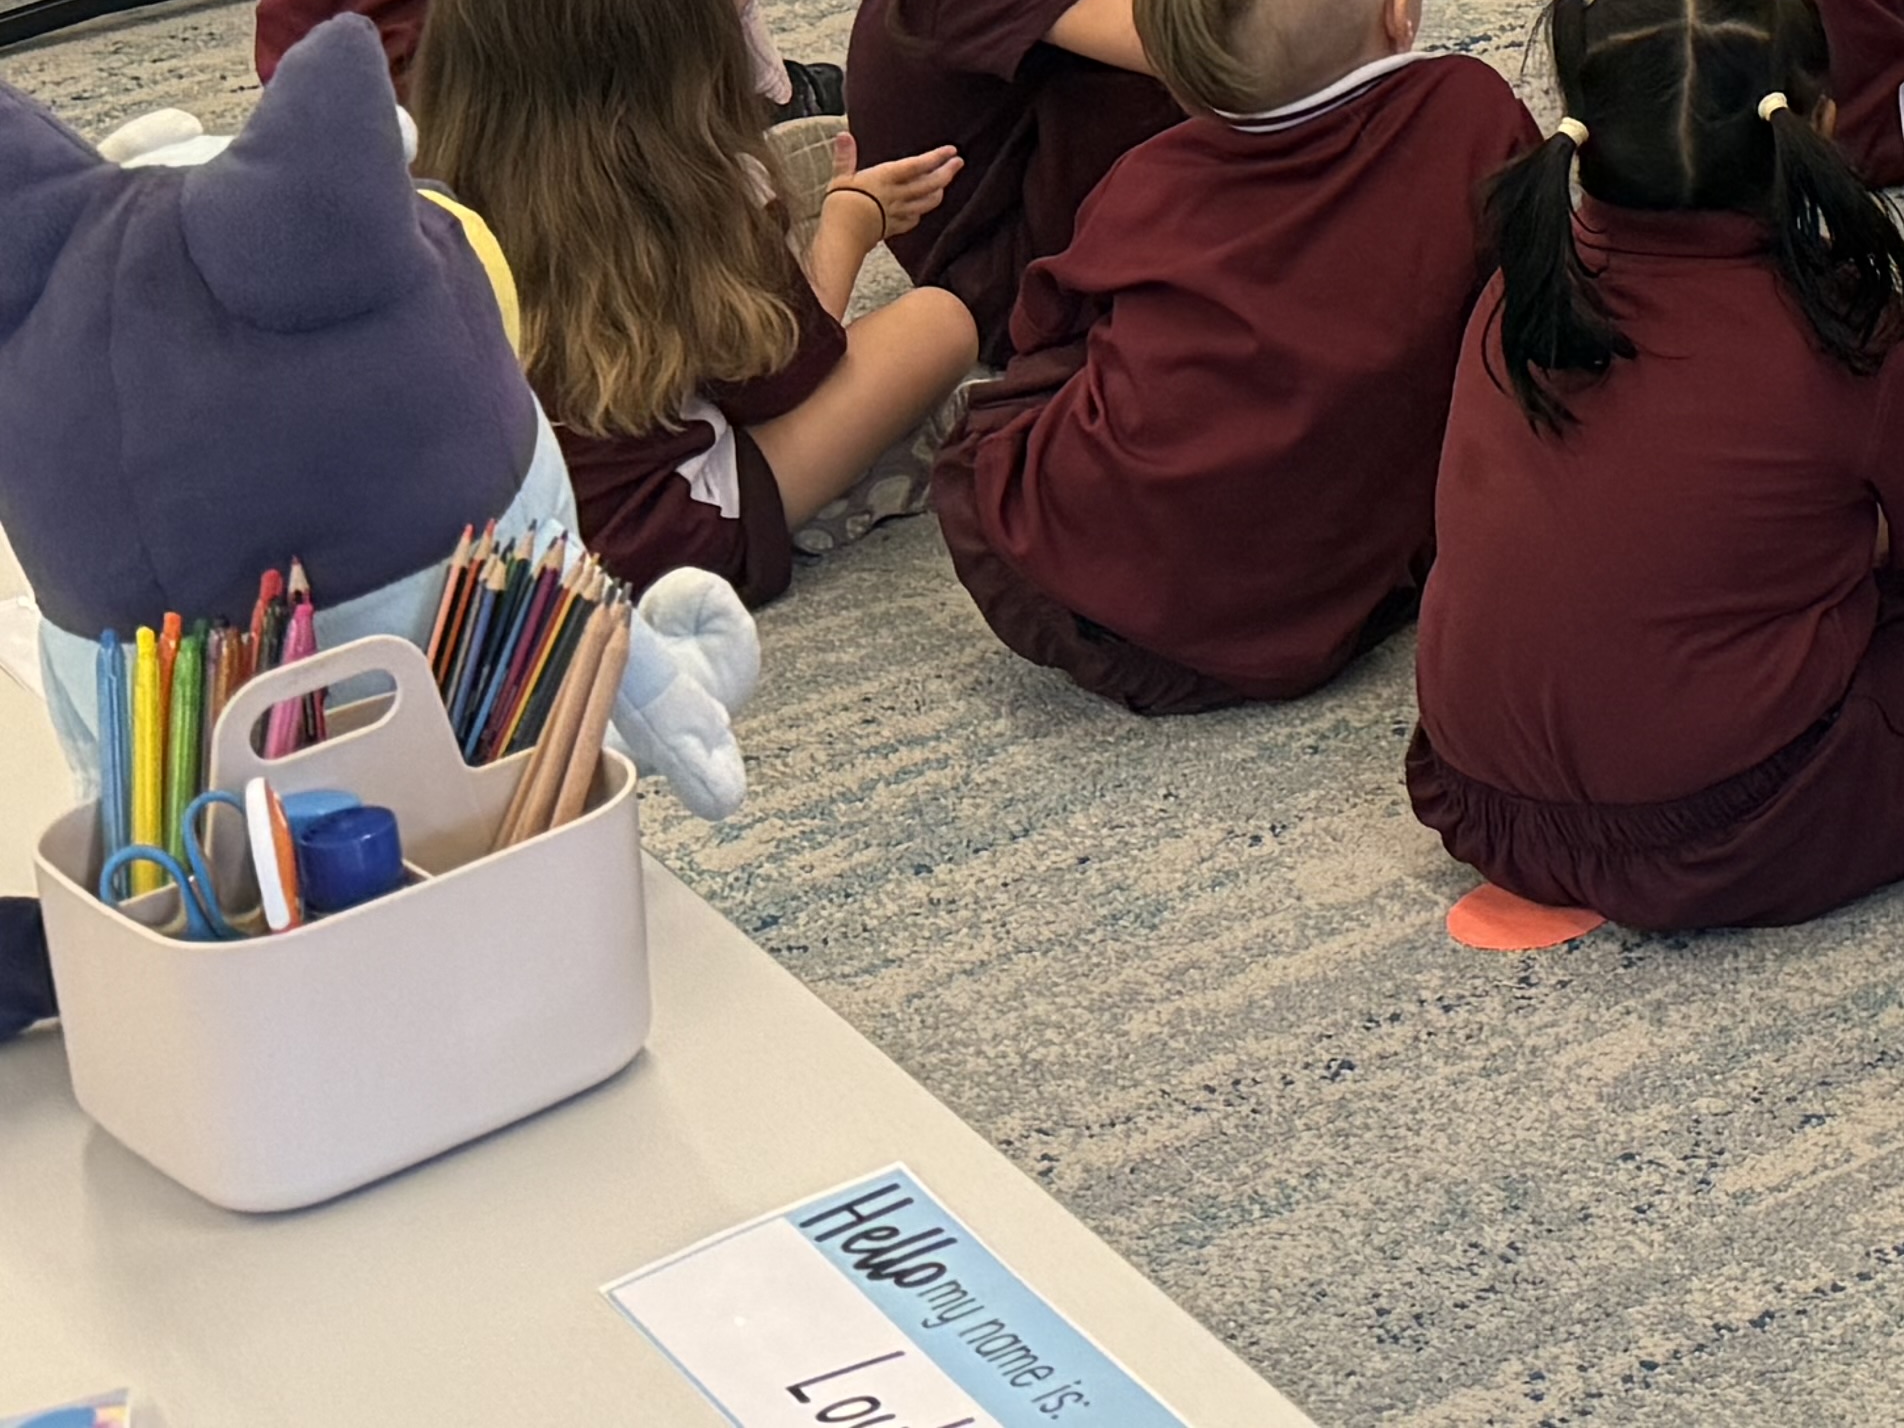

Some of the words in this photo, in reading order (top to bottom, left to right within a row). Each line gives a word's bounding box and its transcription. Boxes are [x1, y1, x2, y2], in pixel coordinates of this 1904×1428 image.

[799, 1182, 959, 1290] Hello
[920, 1272, 984, 1329] my
[958, 1304, 1056, 1389] name
[1031, 1378, 1090, 1421] is:
